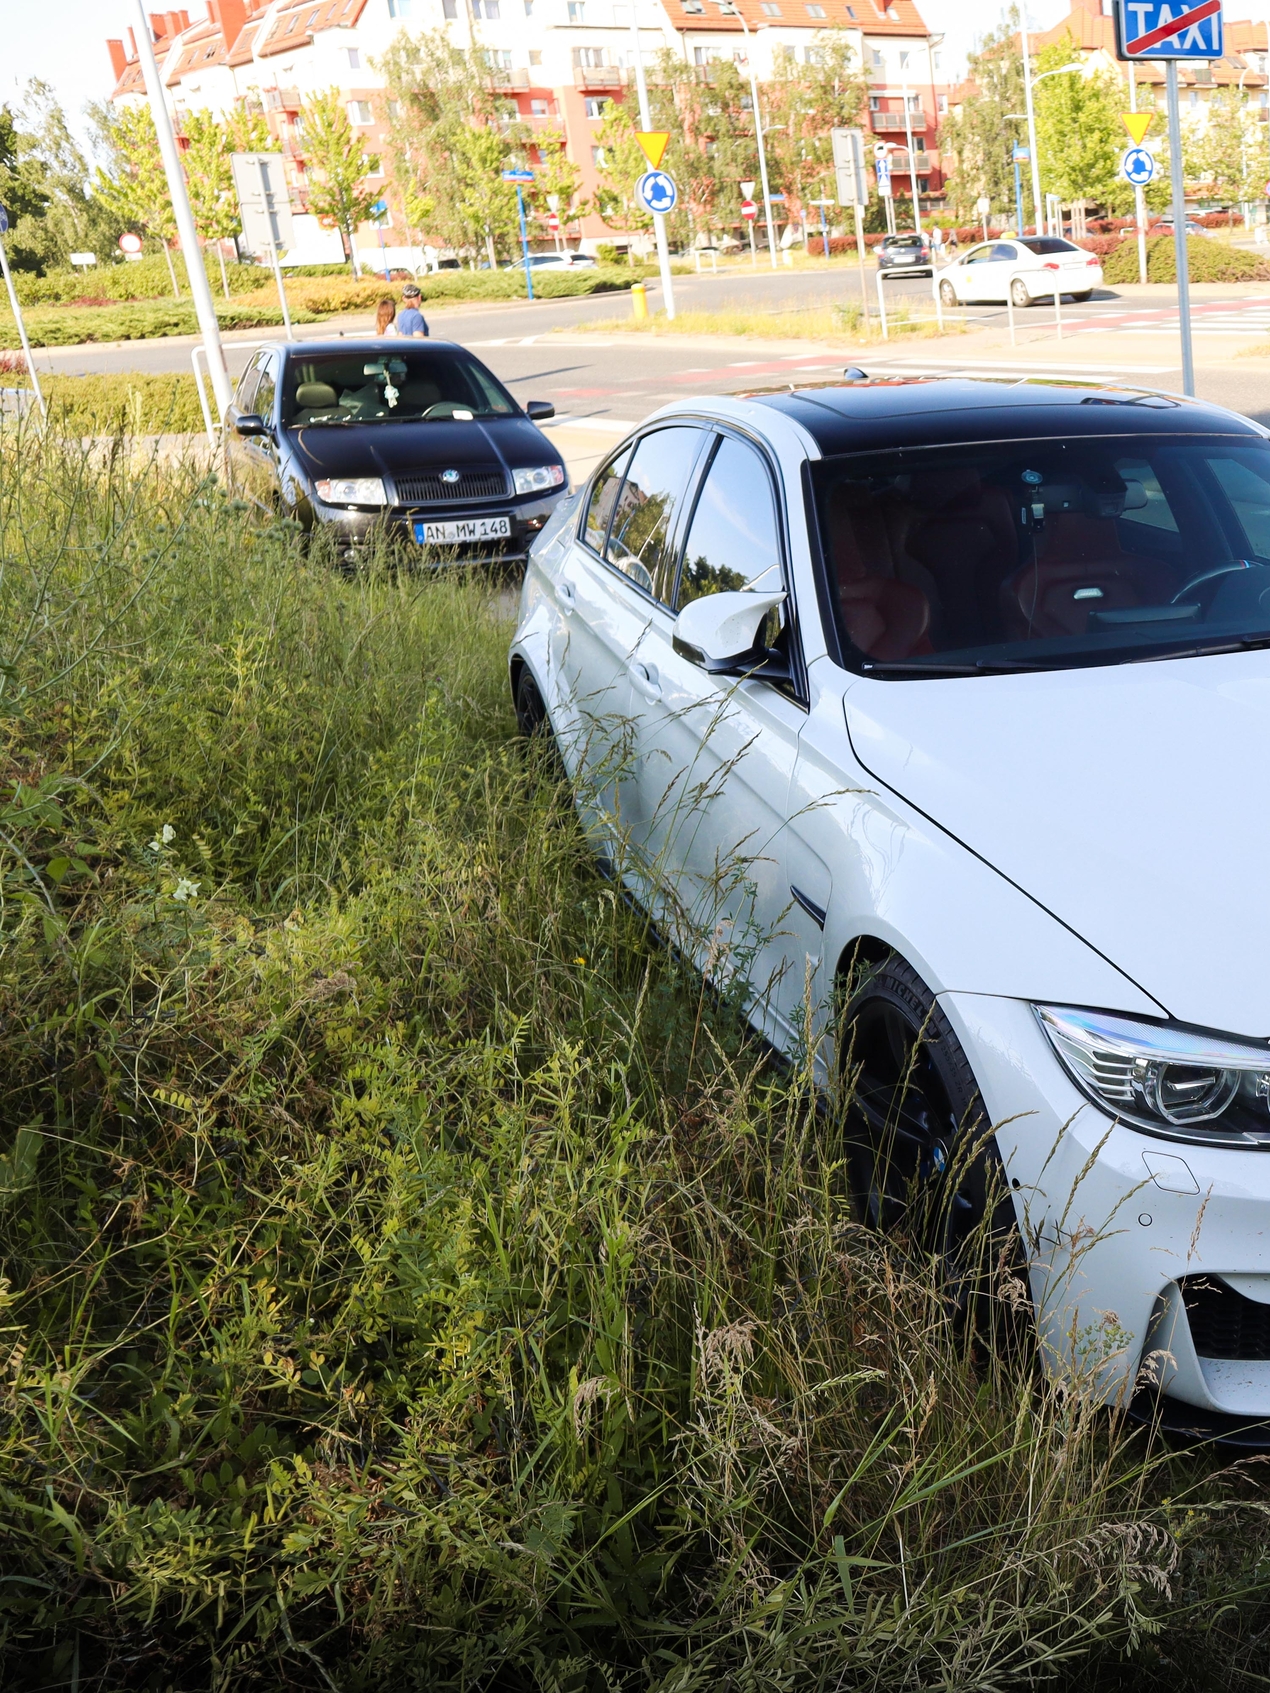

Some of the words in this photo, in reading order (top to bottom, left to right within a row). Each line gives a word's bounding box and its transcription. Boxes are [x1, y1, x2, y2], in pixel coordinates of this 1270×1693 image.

[1127, 3, 1220, 50] TAXI
[427, 525, 446, 540] AN
[456, 522, 476, 538] MW
[480, 520, 508, 536] 148
[884, 976, 939, 1037] MICHELN
